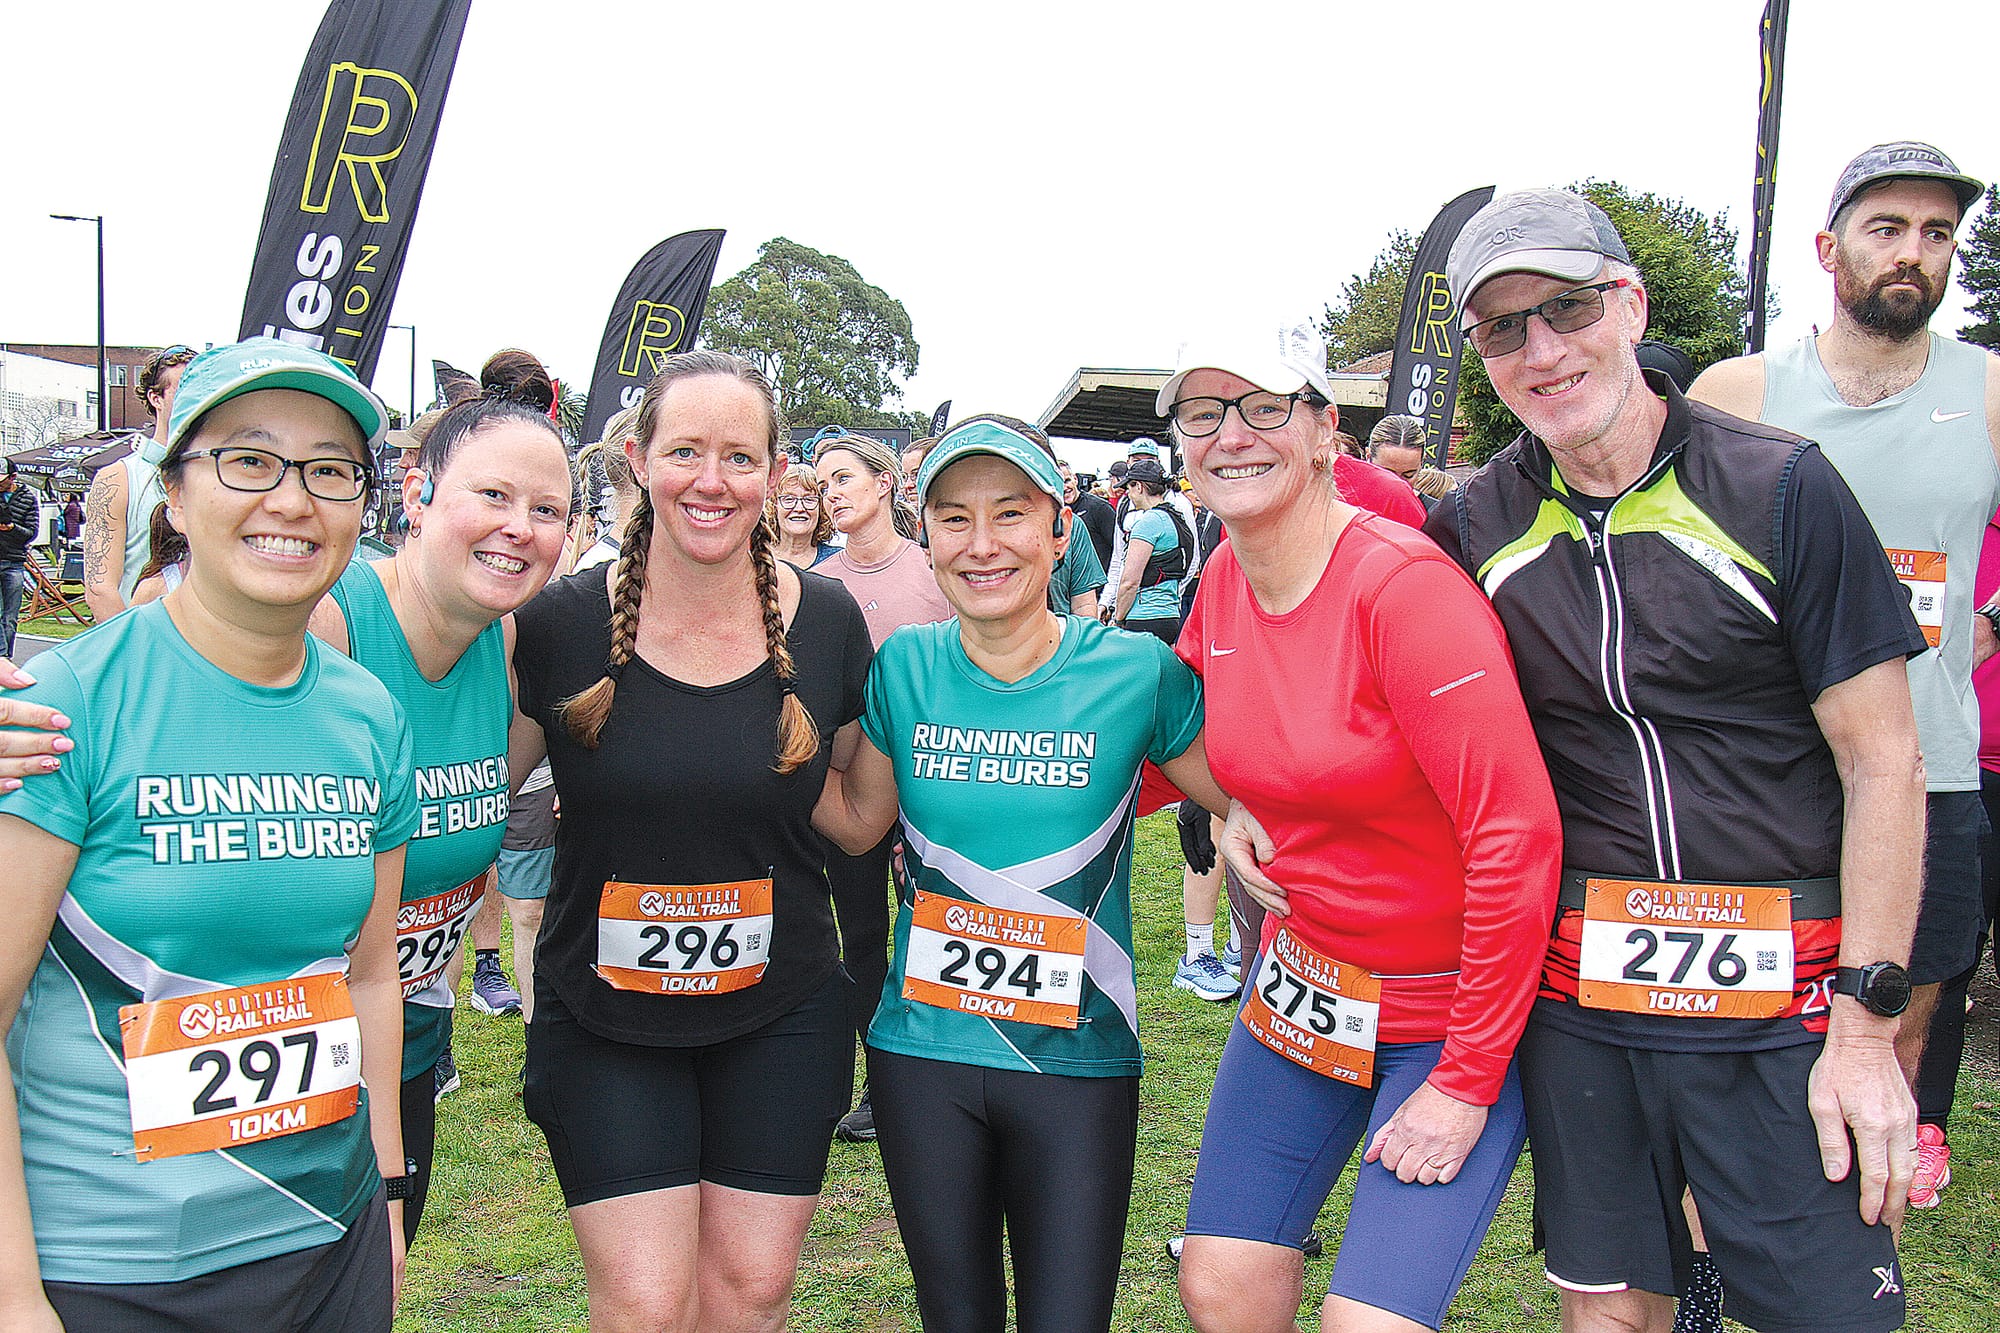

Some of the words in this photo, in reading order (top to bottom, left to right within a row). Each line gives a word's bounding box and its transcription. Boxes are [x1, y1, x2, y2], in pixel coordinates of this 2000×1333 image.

[1491, 225, 1525, 245] OR
[912, 721, 1056, 757] RUNNING
[1060, 731, 1097, 759] IN
[912, 752, 973, 782] THE
[976, 756, 1091, 788] BURBS
[135, 773, 343, 819] RUNNING
[343, 776, 382, 815] IN
[140, 819, 250, 865] THE
[255, 818, 375, 861] BURBS
[414, 911, 445, 927] RAIL
[445, 897, 471, 919] TRAIL
[663, 904, 700, 917] RAIL
[700, 901, 742, 916] TRAIL
[665, 889, 741, 904] SOUTHERN
[1652, 890, 1745, 907] SOUTHERN
[968, 909, 1046, 932] SOUTHERN
[1650, 904, 1695, 922] RAIL
[1695, 906, 1747, 924] TRAIL
[397, 913, 467, 980] 295
[637, 923, 739, 970] 296
[965, 923, 1000, 939] RAIL
[1000, 928, 1047, 946] TRAIL
[939, 940, 1042, 997] 294
[1282, 949, 1303, 974] RAIL
[1303, 964, 1342, 990] TRAIL
[1622, 928, 1747, 987] 276
[660, 976, 719, 992] 10KM
[1262, 960, 1337, 1035] 275
[214, 986, 305, 1015] SOUTHERN
[958, 993, 1016, 1017] 10KM
[1648, 990, 1720, 1014] 10KM
[215, 1012, 264, 1035] RAIL
[262, 1003, 313, 1027] TRAIL
[1270, 1015, 1316, 1050] 10KM
[1265, 1034, 1283, 1051] TAG
[1285, 1045, 1314, 1066] 10KM
[189, 1031, 319, 1115] 297
[1332, 1066, 1360, 1081] 275
[229, 1104, 307, 1141] 10KM
